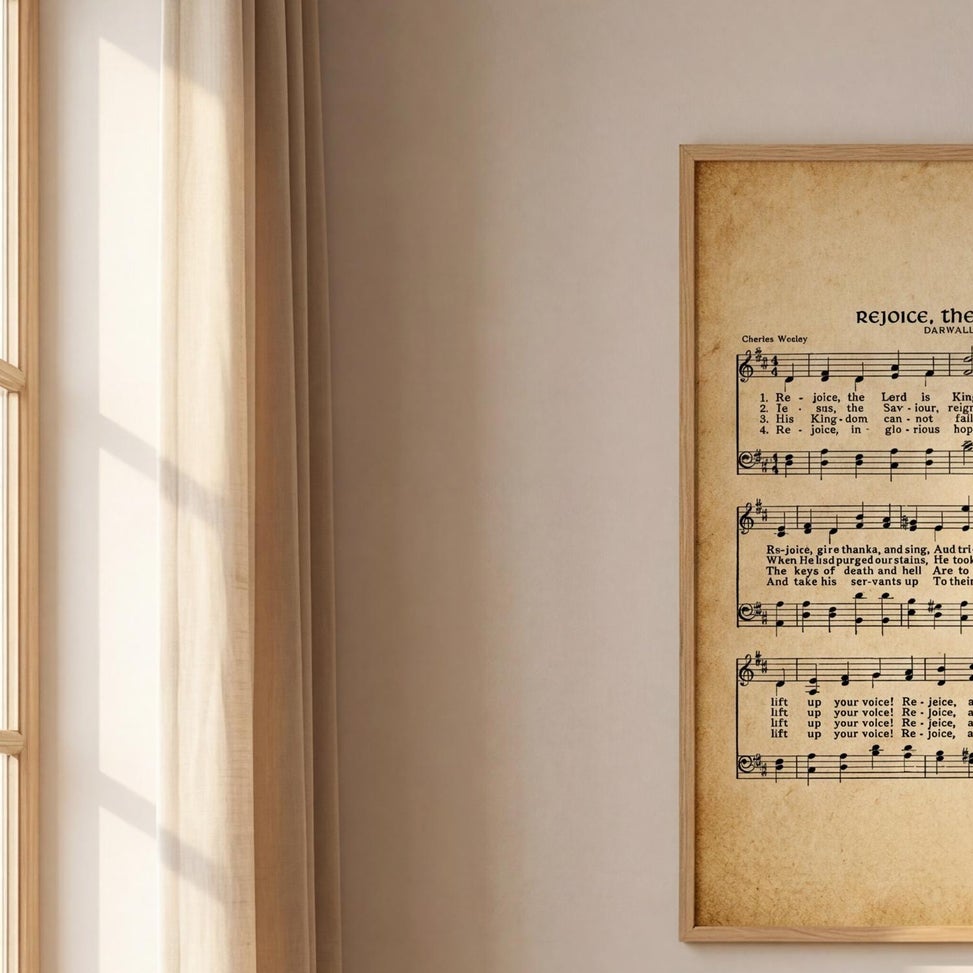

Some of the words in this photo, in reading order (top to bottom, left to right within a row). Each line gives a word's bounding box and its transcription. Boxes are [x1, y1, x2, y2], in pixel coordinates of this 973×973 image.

[759, 392, 768, 403] 1.
[812, 392, 840, 405] joice,
[848, 392, 865, 402] the
[921, 392, 930, 402] is
[759, 403, 769, 413] 2.
[847, 403, 864, 413] the
[759, 414, 769, 424] 3.
[776, 414, 794, 424] His
[915, 413, 933, 423] not
[759, 424, 769, 434] 4.
[810, 424, 839, 436] joice,
[913, 424, 940, 434] rious
[884, 544, 902, 554] and
[905, 544, 930, 556] sing,
[799, 555, 814, 565] He
[836, 555, 873, 567] purged
[875, 557, 894, 565] our
[934, 554, 949, 565] He
[766, 565, 787, 575] The
[794, 565, 819, 578] keys
[824, 565, 836, 575] of
[844, 565, 874, 575] death
[878, 565, 897, 575] and
[902, 565, 922, 575] hell
[933, 565, 953, 575] Are
[958, 565, 969, 575] to
[766, 576, 789, 586] And
[794, 576, 818, 586] take
[821, 576, 837, 586] his
[905, 578, 919, 588] up
[933, 576, 947, 586] To
[771, 697, 788, 707] lift
[807, 699, 822, 709] up
[834, 699, 859, 709] your
[862, 696, 894, 707] voice!
[771, 707, 788, 717] lift
[807, 709, 822, 720] up
[834, 709, 859, 720] your
[771, 718, 788, 728] lift
[807, 720, 822, 730] up
[834, 720, 859, 730] your
[771, 728, 788, 739] lift
[807, 731, 822, 741] up
[834, 730, 859, 741] your
[862, 728, 894, 739] voice!
